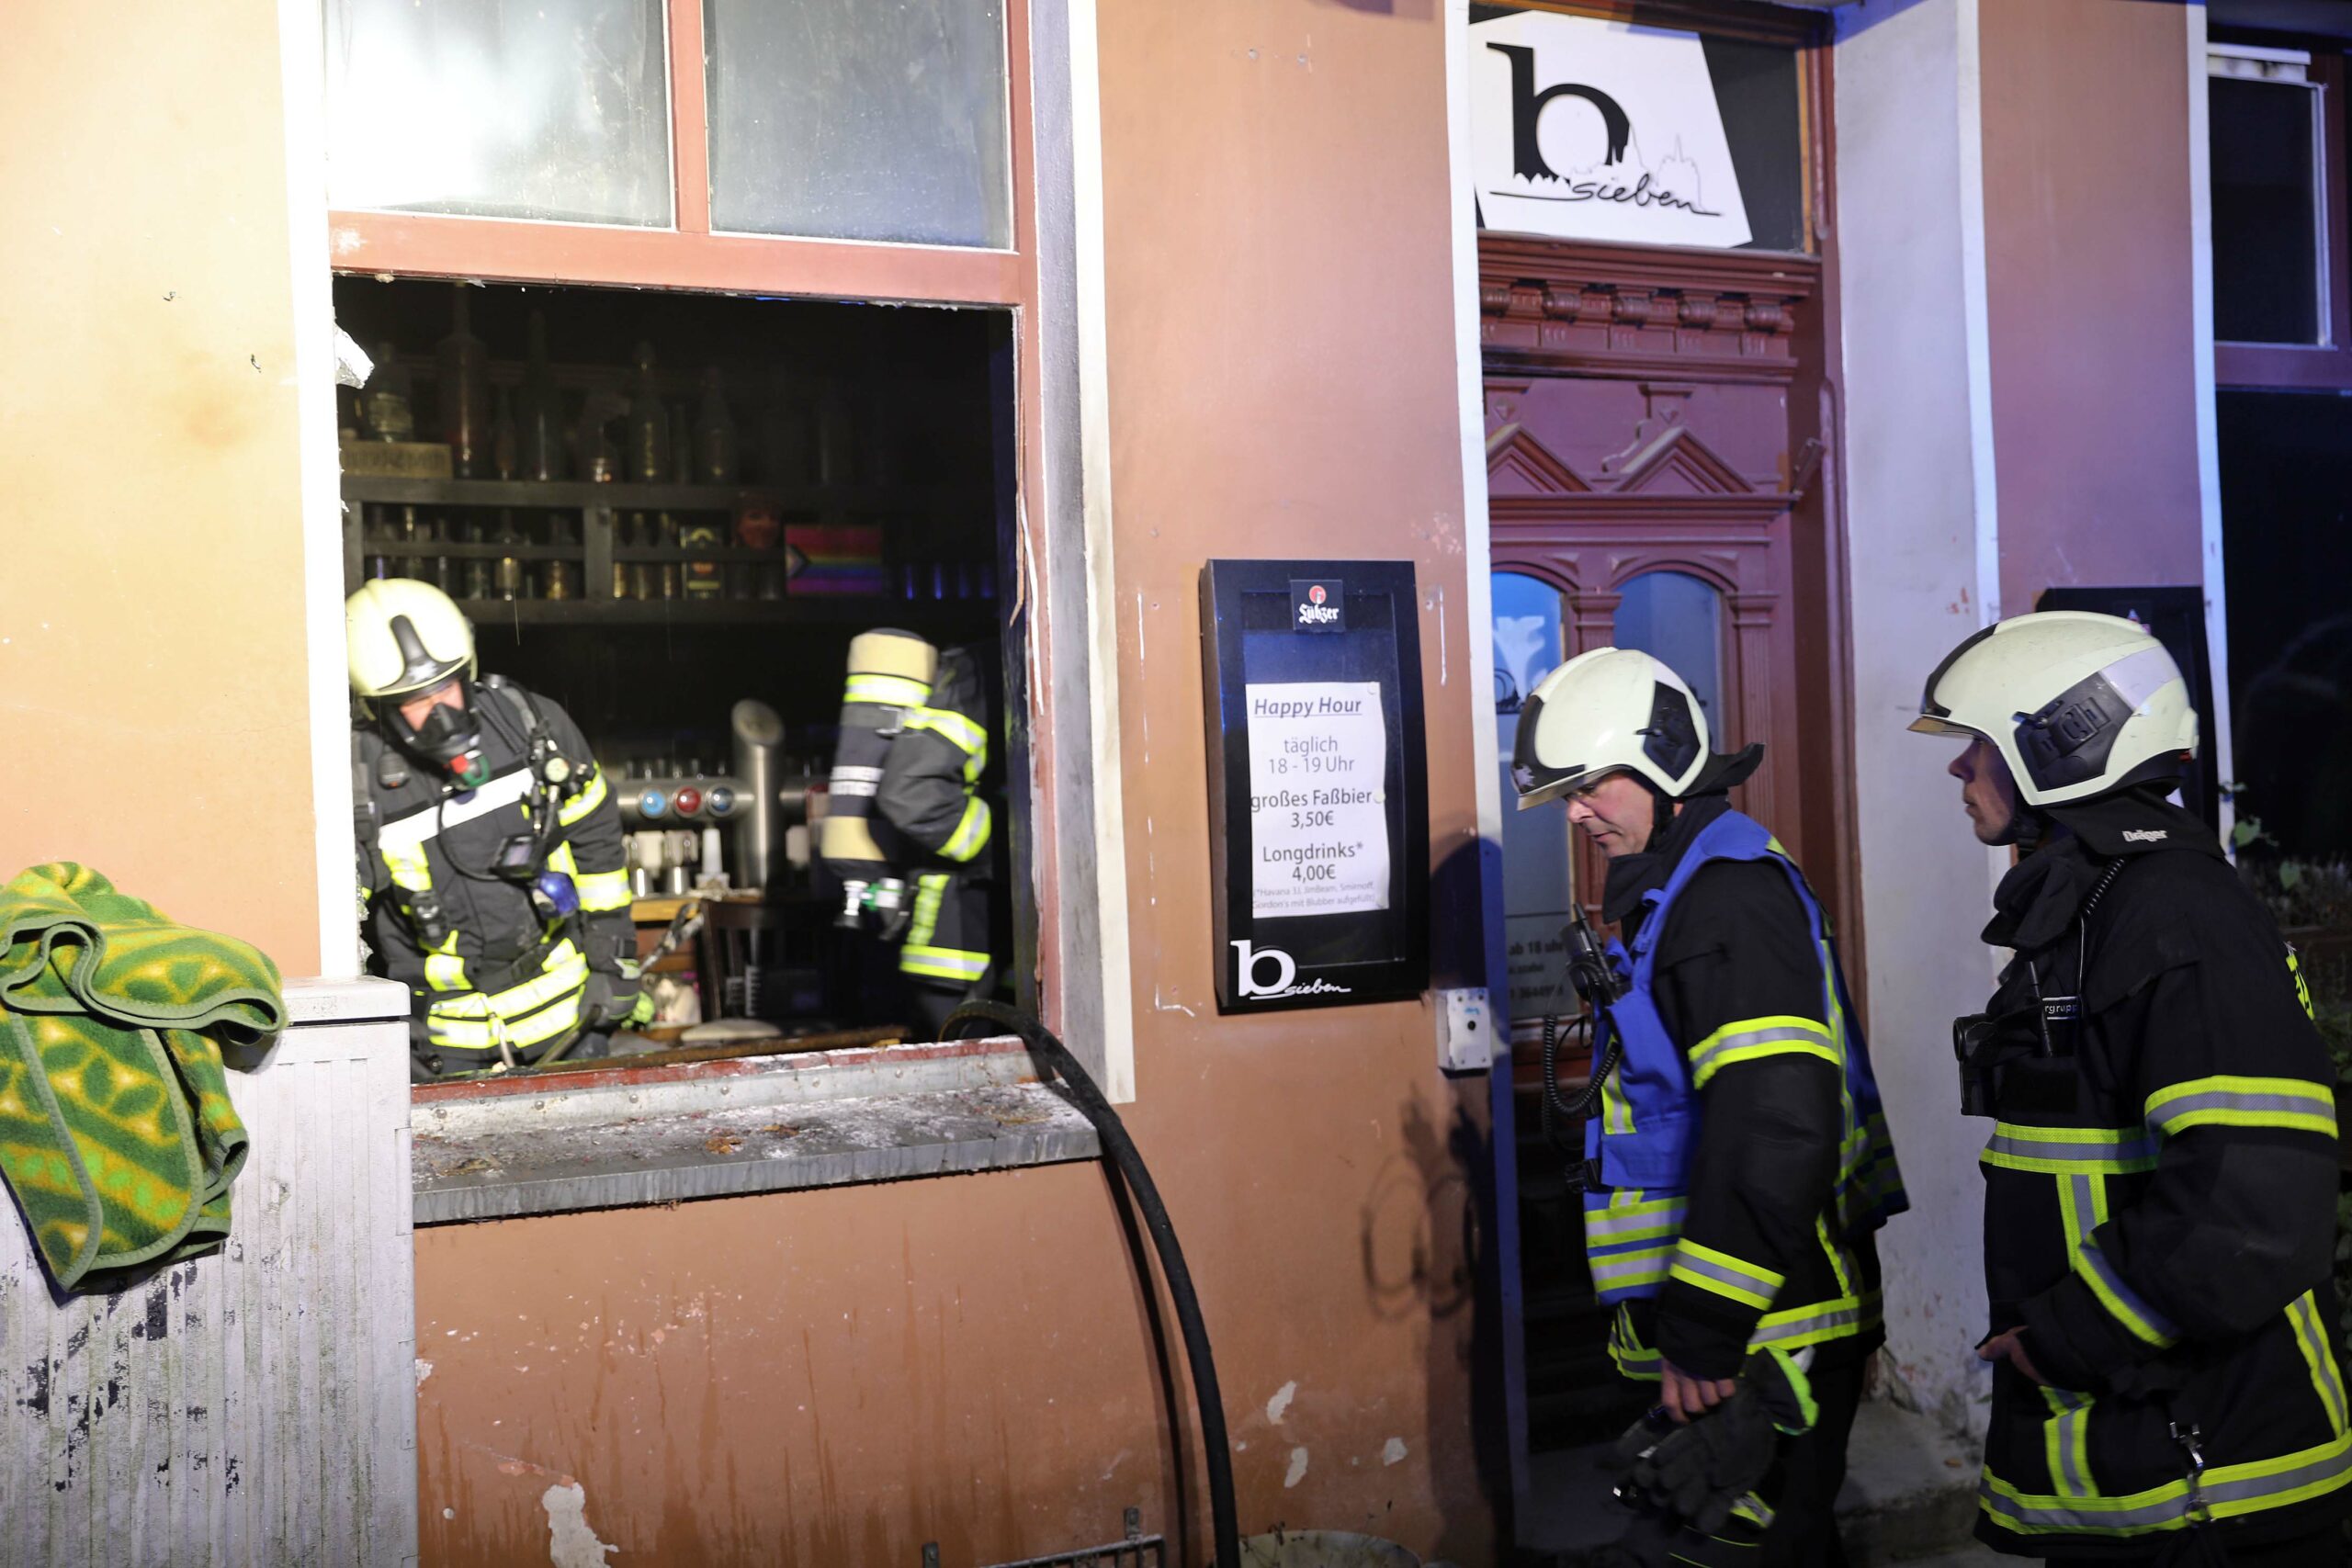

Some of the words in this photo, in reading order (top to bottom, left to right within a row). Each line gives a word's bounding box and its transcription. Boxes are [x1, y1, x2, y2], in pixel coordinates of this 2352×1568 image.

[1571, 173, 1723, 217] sieben
[1254, 698, 1314, 718] Happy
[1318, 696, 1362, 714] Hour
[1283, 735, 1338, 757] täglich
[1269, 758, 1288, 774] 18
[1304, 756, 1321, 773] 19
[1326, 755, 1355, 773] Uhr
[1250, 789, 1308, 813] großes
[1312, 788, 1373, 806] Faßbier
[1291, 810, 1335, 829] 3,50€
[1292, 863, 1337, 883] 4,00€
[1290, 898, 1305, 908] mit
[1229, 939, 1296, 997] b
[1284, 977, 1352, 996] sieben
